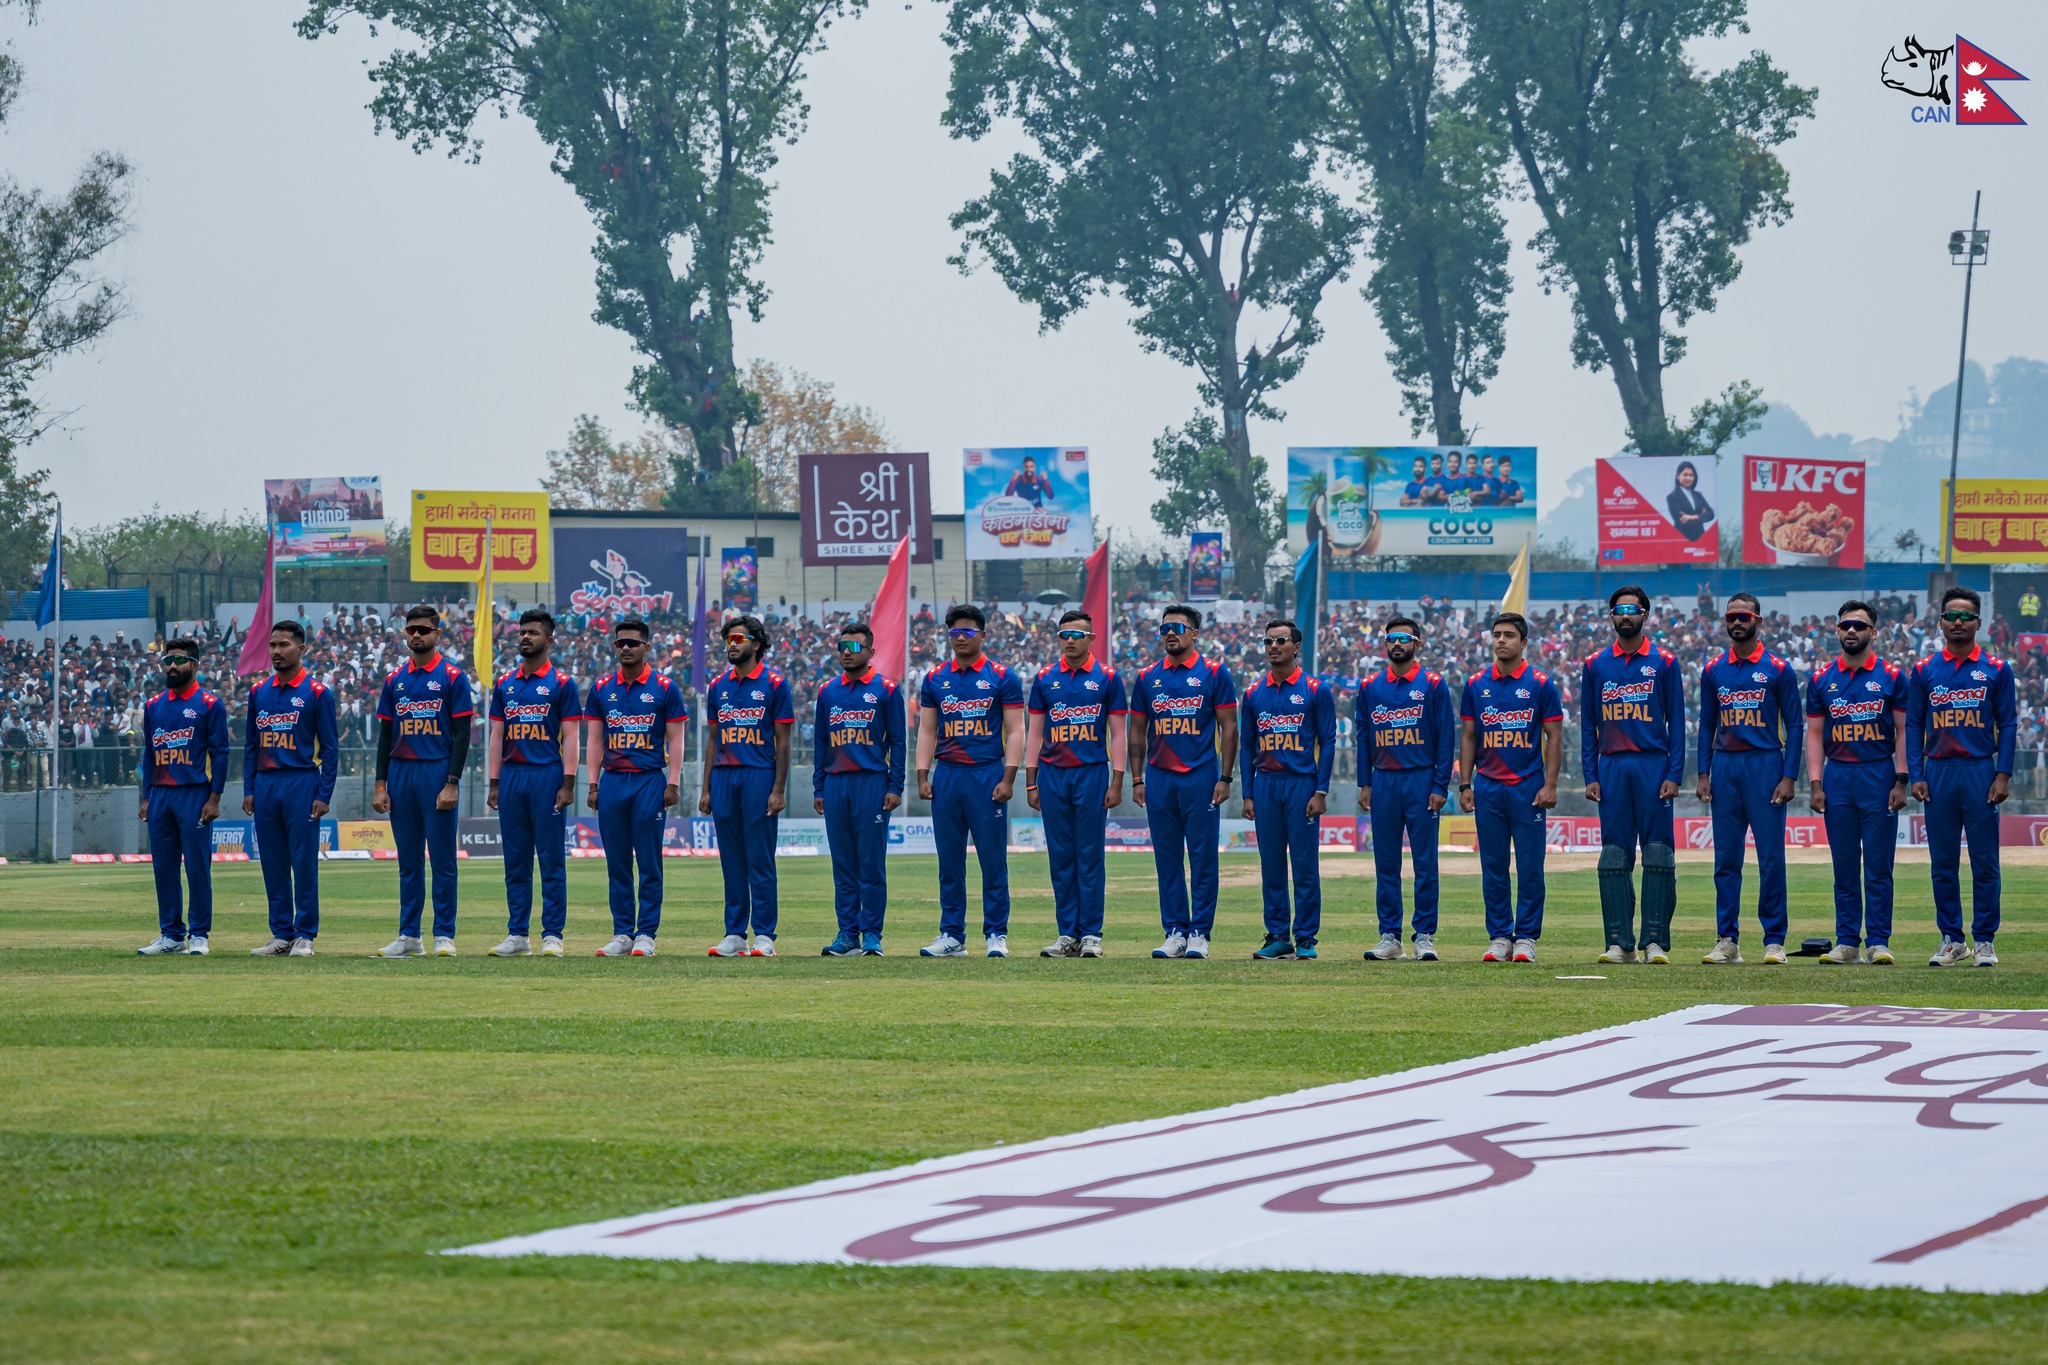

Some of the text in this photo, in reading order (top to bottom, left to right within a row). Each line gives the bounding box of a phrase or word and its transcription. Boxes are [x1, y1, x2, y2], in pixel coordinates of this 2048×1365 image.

[859, 462, 899, 502] श्री
[1780, 464, 1859, 495] KFC
[301, 509, 350, 527] EUROPE
[830, 501, 901, 540] केश
[1337, 521, 1363, 529] COCO
[1429, 517, 1493, 535] COCO
[824, 545, 864, 554] SHREE
[878, 545, 898, 554] KE
[582, 580, 607, 597] My
[570, 590, 673, 614] Second
[1602, 680, 1654, 702] Second
[1718, 689, 1766, 706] Second
[1930, 686, 1987, 706] Second
[396, 699, 443, 716] Second
[504, 704, 551, 719] Second
[942, 697, 993, 714] Second
[1050, 703, 1102, 721] Second
[1152, 695, 1204, 713] Second
[1602, 703, 1653, 721] NEPAL
[1829, 699, 1884, 719] Second
[257, 711, 300, 729] Second
[606, 713, 656, 729] Second
[718, 707, 766, 723] Second
[830, 709, 875, 726] Second
[1257, 712, 1304, 731] Second
[1371, 705, 1423, 724] Second
[1481, 708, 1534, 726] Second
[1721, 709, 1765, 727] NEPAL
[1933, 710, 1984, 729] NEPAL
[507, 724, 549, 740] NEPAL
[945, 720, 992, 737] NEPAL
[1051, 725, 1098, 743] NEPAL
[1155, 718, 1200, 735] NEPAL
[1832, 724, 1885, 741] NEPAL
[153, 727, 194, 746] Second
[609, 734, 653, 749] NEPAL
[722, 728, 764, 744] NEPAL
[830, 729, 873, 747] NEPAL
[1259, 734, 1304, 751] NEPAL
[1375, 729, 1424, 746] NEPAL
[1483, 731, 1532, 748] NEPAL
[155, 749, 192, 765] NEPAL
[212, 831, 245, 844] ENERGY
[906, 825, 933, 835] GRA
[462, 834, 502, 844] KEL
[1806, 1009, 2016, 1026] KESH
